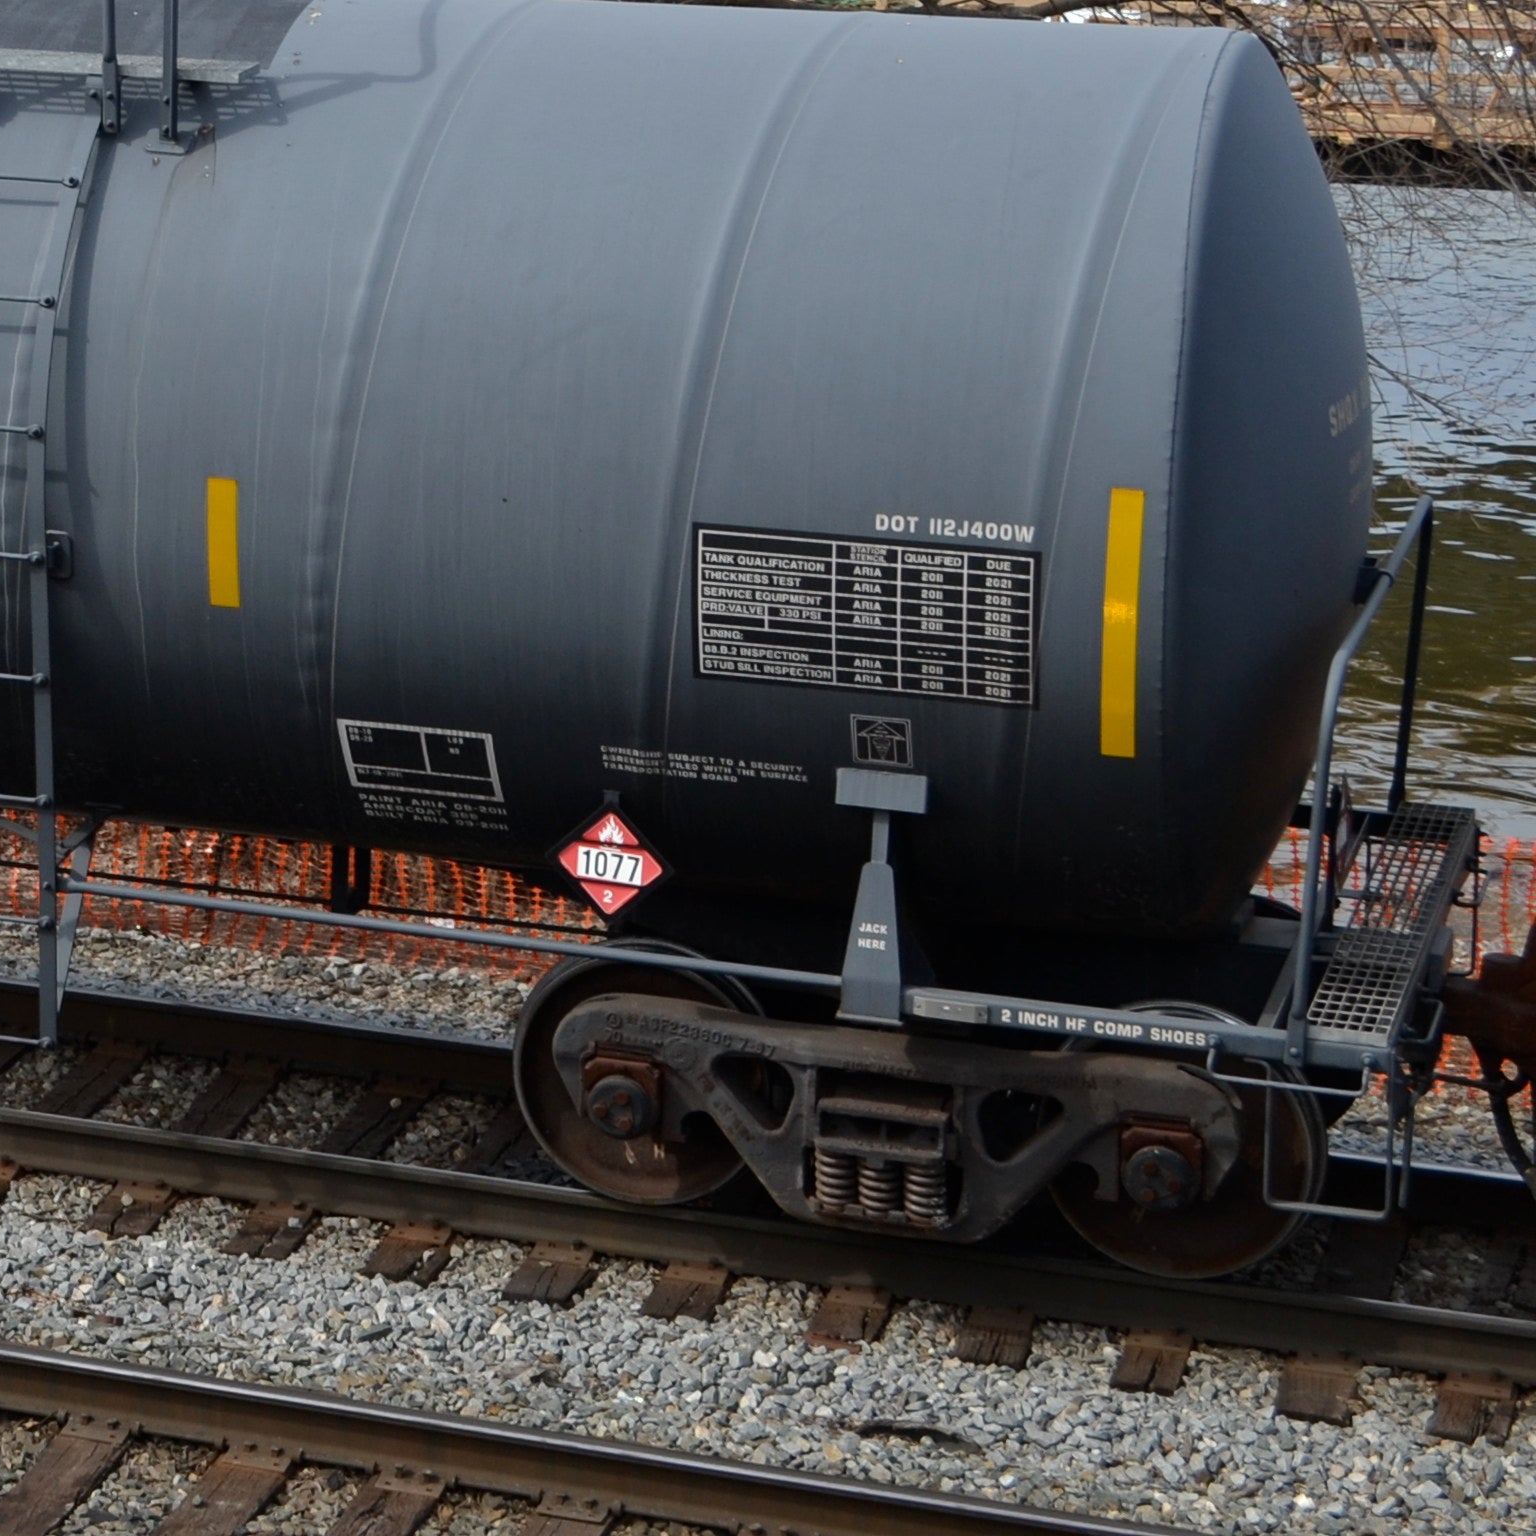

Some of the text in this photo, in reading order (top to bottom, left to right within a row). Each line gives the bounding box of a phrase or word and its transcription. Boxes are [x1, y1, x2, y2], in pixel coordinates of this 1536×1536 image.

[875, 514, 1035, 544] DOT 112J400W
[850, 546, 887, 555] STATION
[703, 552, 825, 572] TANK QUALIFICATION
[850, 553, 887, 564] STENCIL
[904, 552, 962, 567] QUALIFIED
[853, 565, 882, 578] ARIA
[986, 559, 1011, 572] DUE
[703, 569, 802, 587] THICKNESS TEST
[985, 577, 1012, 589] 2021
[853, 582, 882, 594] ARIA
[703, 586, 823, 606] SERVICE EQUIPMENT
[985, 595, 1012, 606] 2021
[853, 600, 882, 611] ARIA
[779, 608, 800, 619] 330
[802, 609, 822, 621] PSI
[853, 615, 882, 626] ARIA
[984, 611, 1011, 623] 2021
[703, 627, 744, 640] LINING:
[984, 626, 1011, 638] 2021
[740, 647, 810, 662] INSPECTION
[704, 659, 832, 680] STUB SILL INSPECTION
[853, 658, 882, 670] ARIA
[854, 673, 883, 685] ARIA
[985, 670, 1011, 682] 2021
[985, 686, 1011, 698] 2021
[600, 745, 803, 773] OWNERSHIP SUBJECT TO A SECURITY
[602, 754, 808, 782] AGREEMENT FILED WITH THE SURFACE
[603, 761, 738, 783] TRANSPORTATION BOARD
[358, 792, 404, 805] PAINT
[411, 798, 447, 810] ARIA
[363, 801, 442, 816] AMERCOAT
[365, 809, 405, 820] BUILT
[413, 815, 449, 826] ARIA
[582, 848, 640, 883] 1077
[602, 889, 613, 904] 2
[858, 922, 888, 935] JACK
[857, 937, 886, 951] HERE
[1001, 1009, 1207, 1047] 2 INCH HF COMP SHOES
